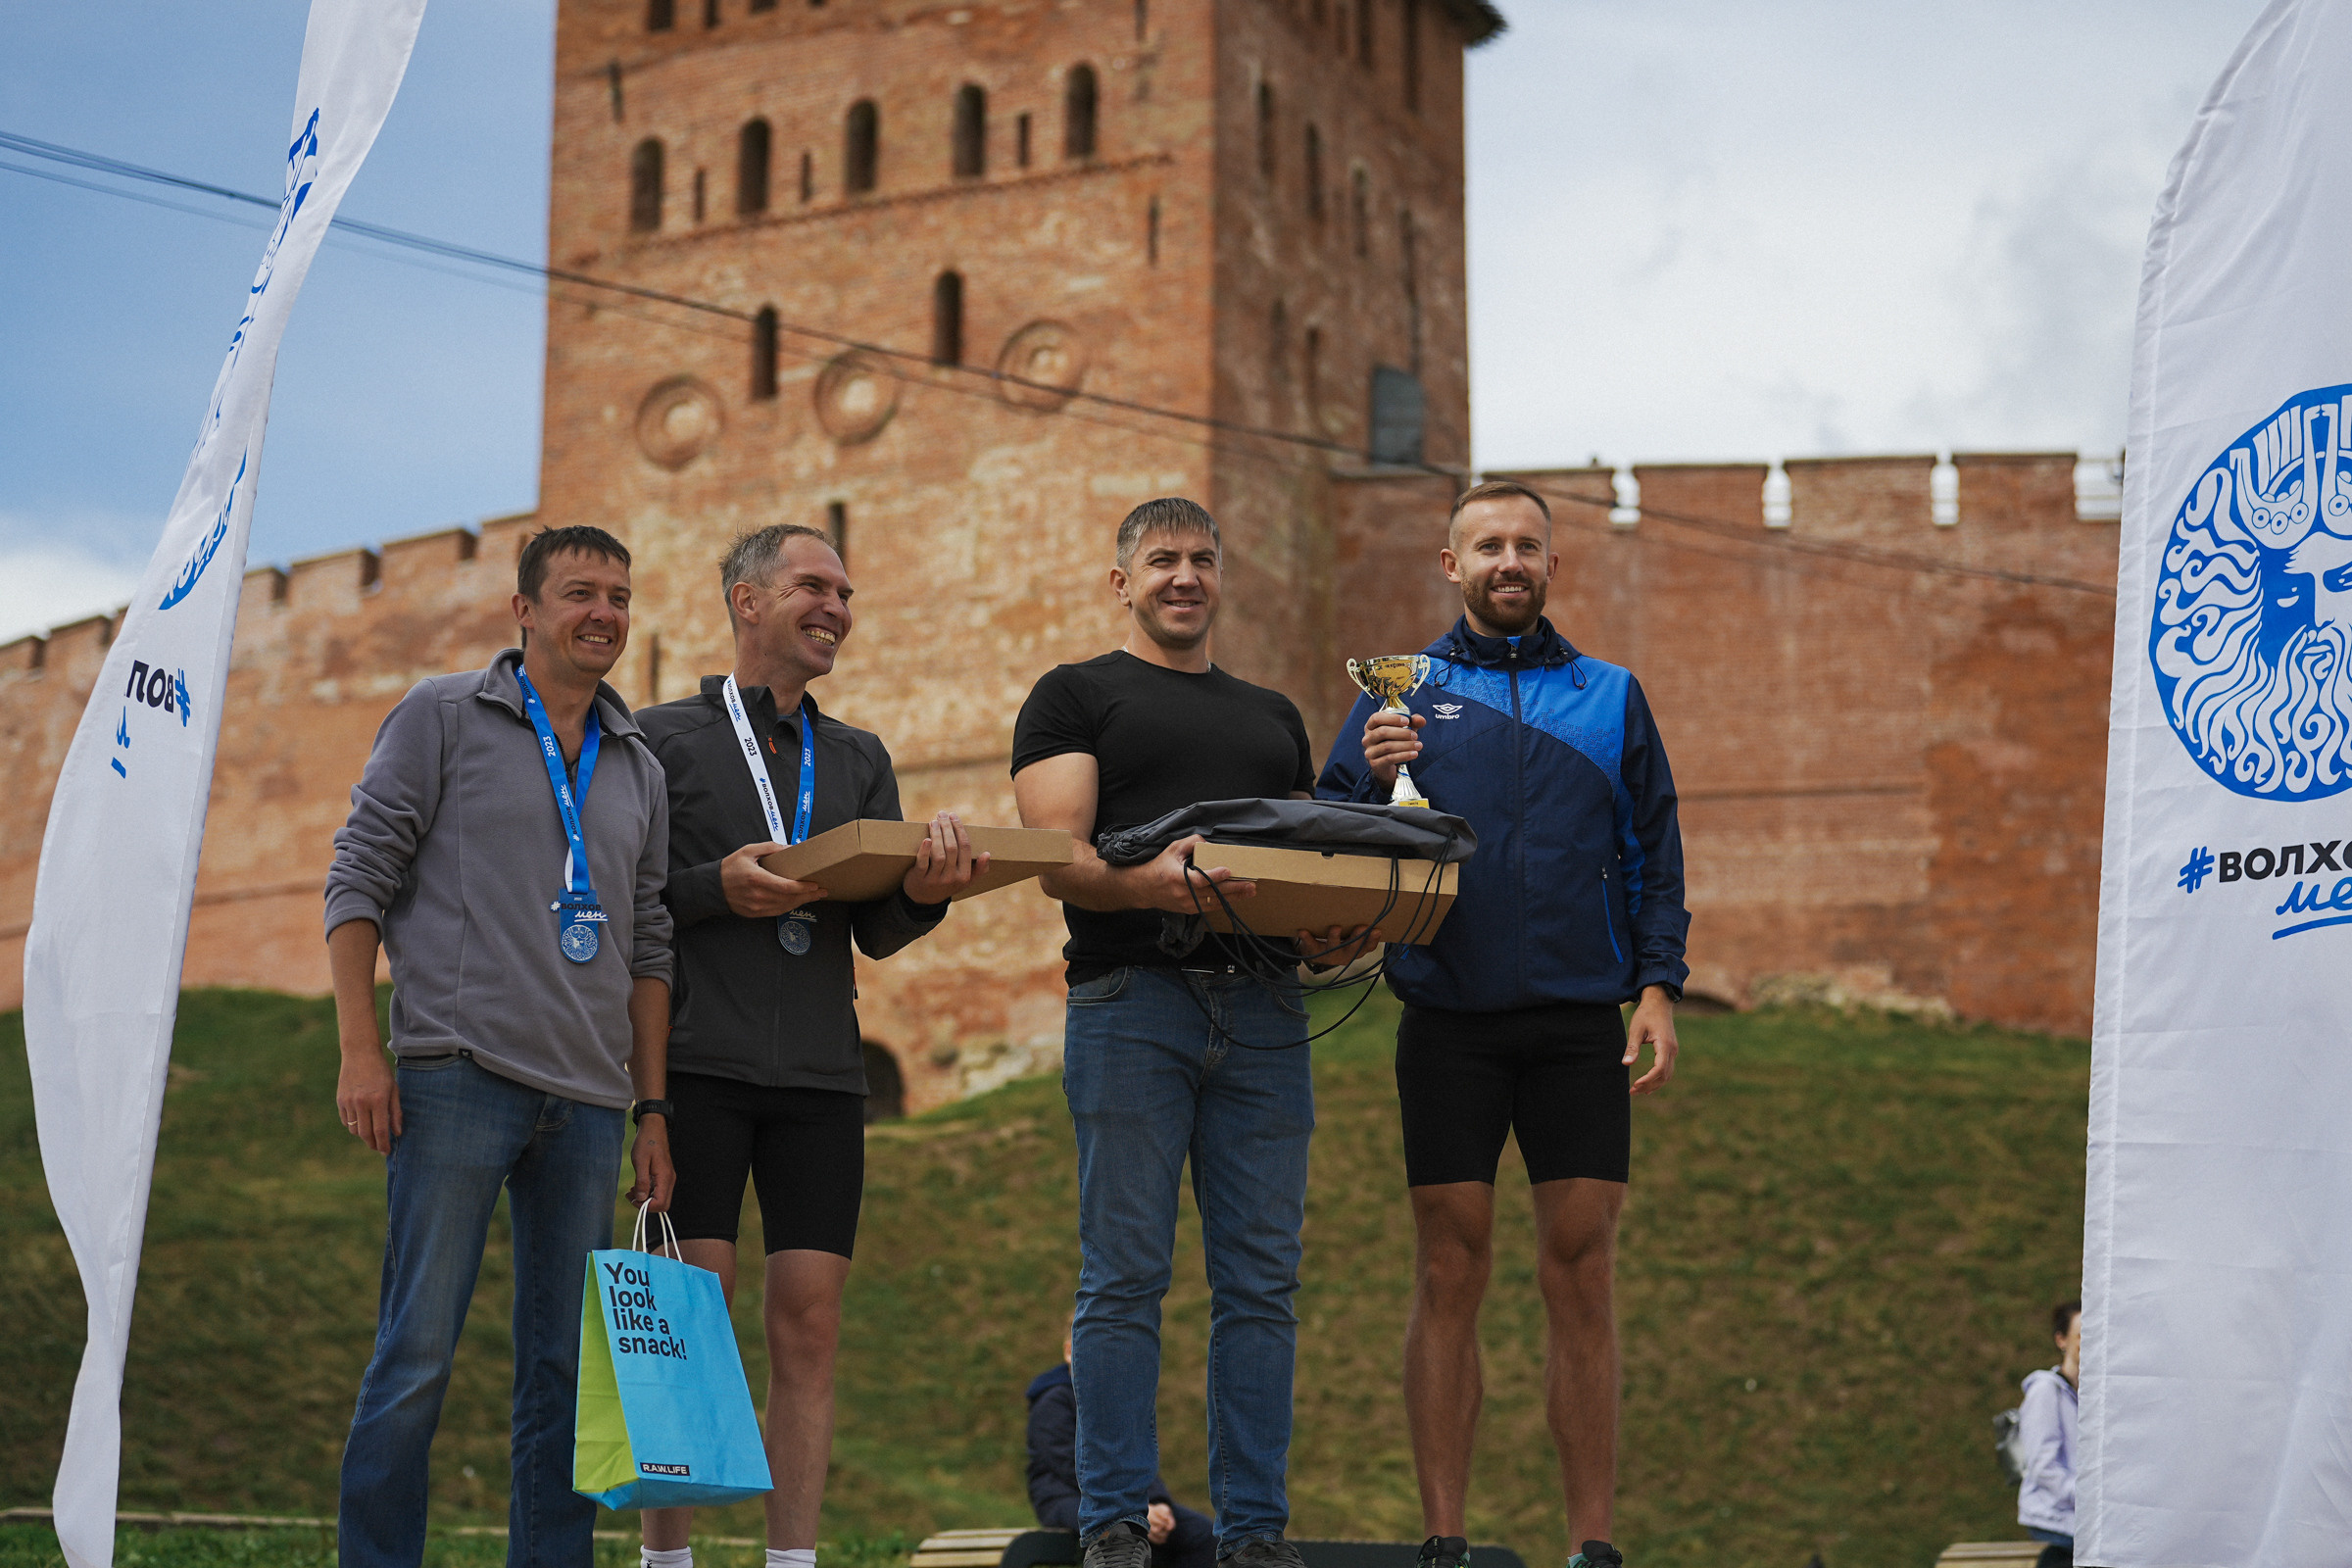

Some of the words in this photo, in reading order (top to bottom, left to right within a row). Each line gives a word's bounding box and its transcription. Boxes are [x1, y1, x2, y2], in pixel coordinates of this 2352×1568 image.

[543, 736, 556, 758] 2023
[745, 737, 758, 757] 2023
[604, 1261, 650, 1287] You
[609, 1285, 658, 1311] look
[614, 1308, 654, 1332] like
[659, 1317, 670, 1335] a
[618, 1335, 687, 1360] snack!
